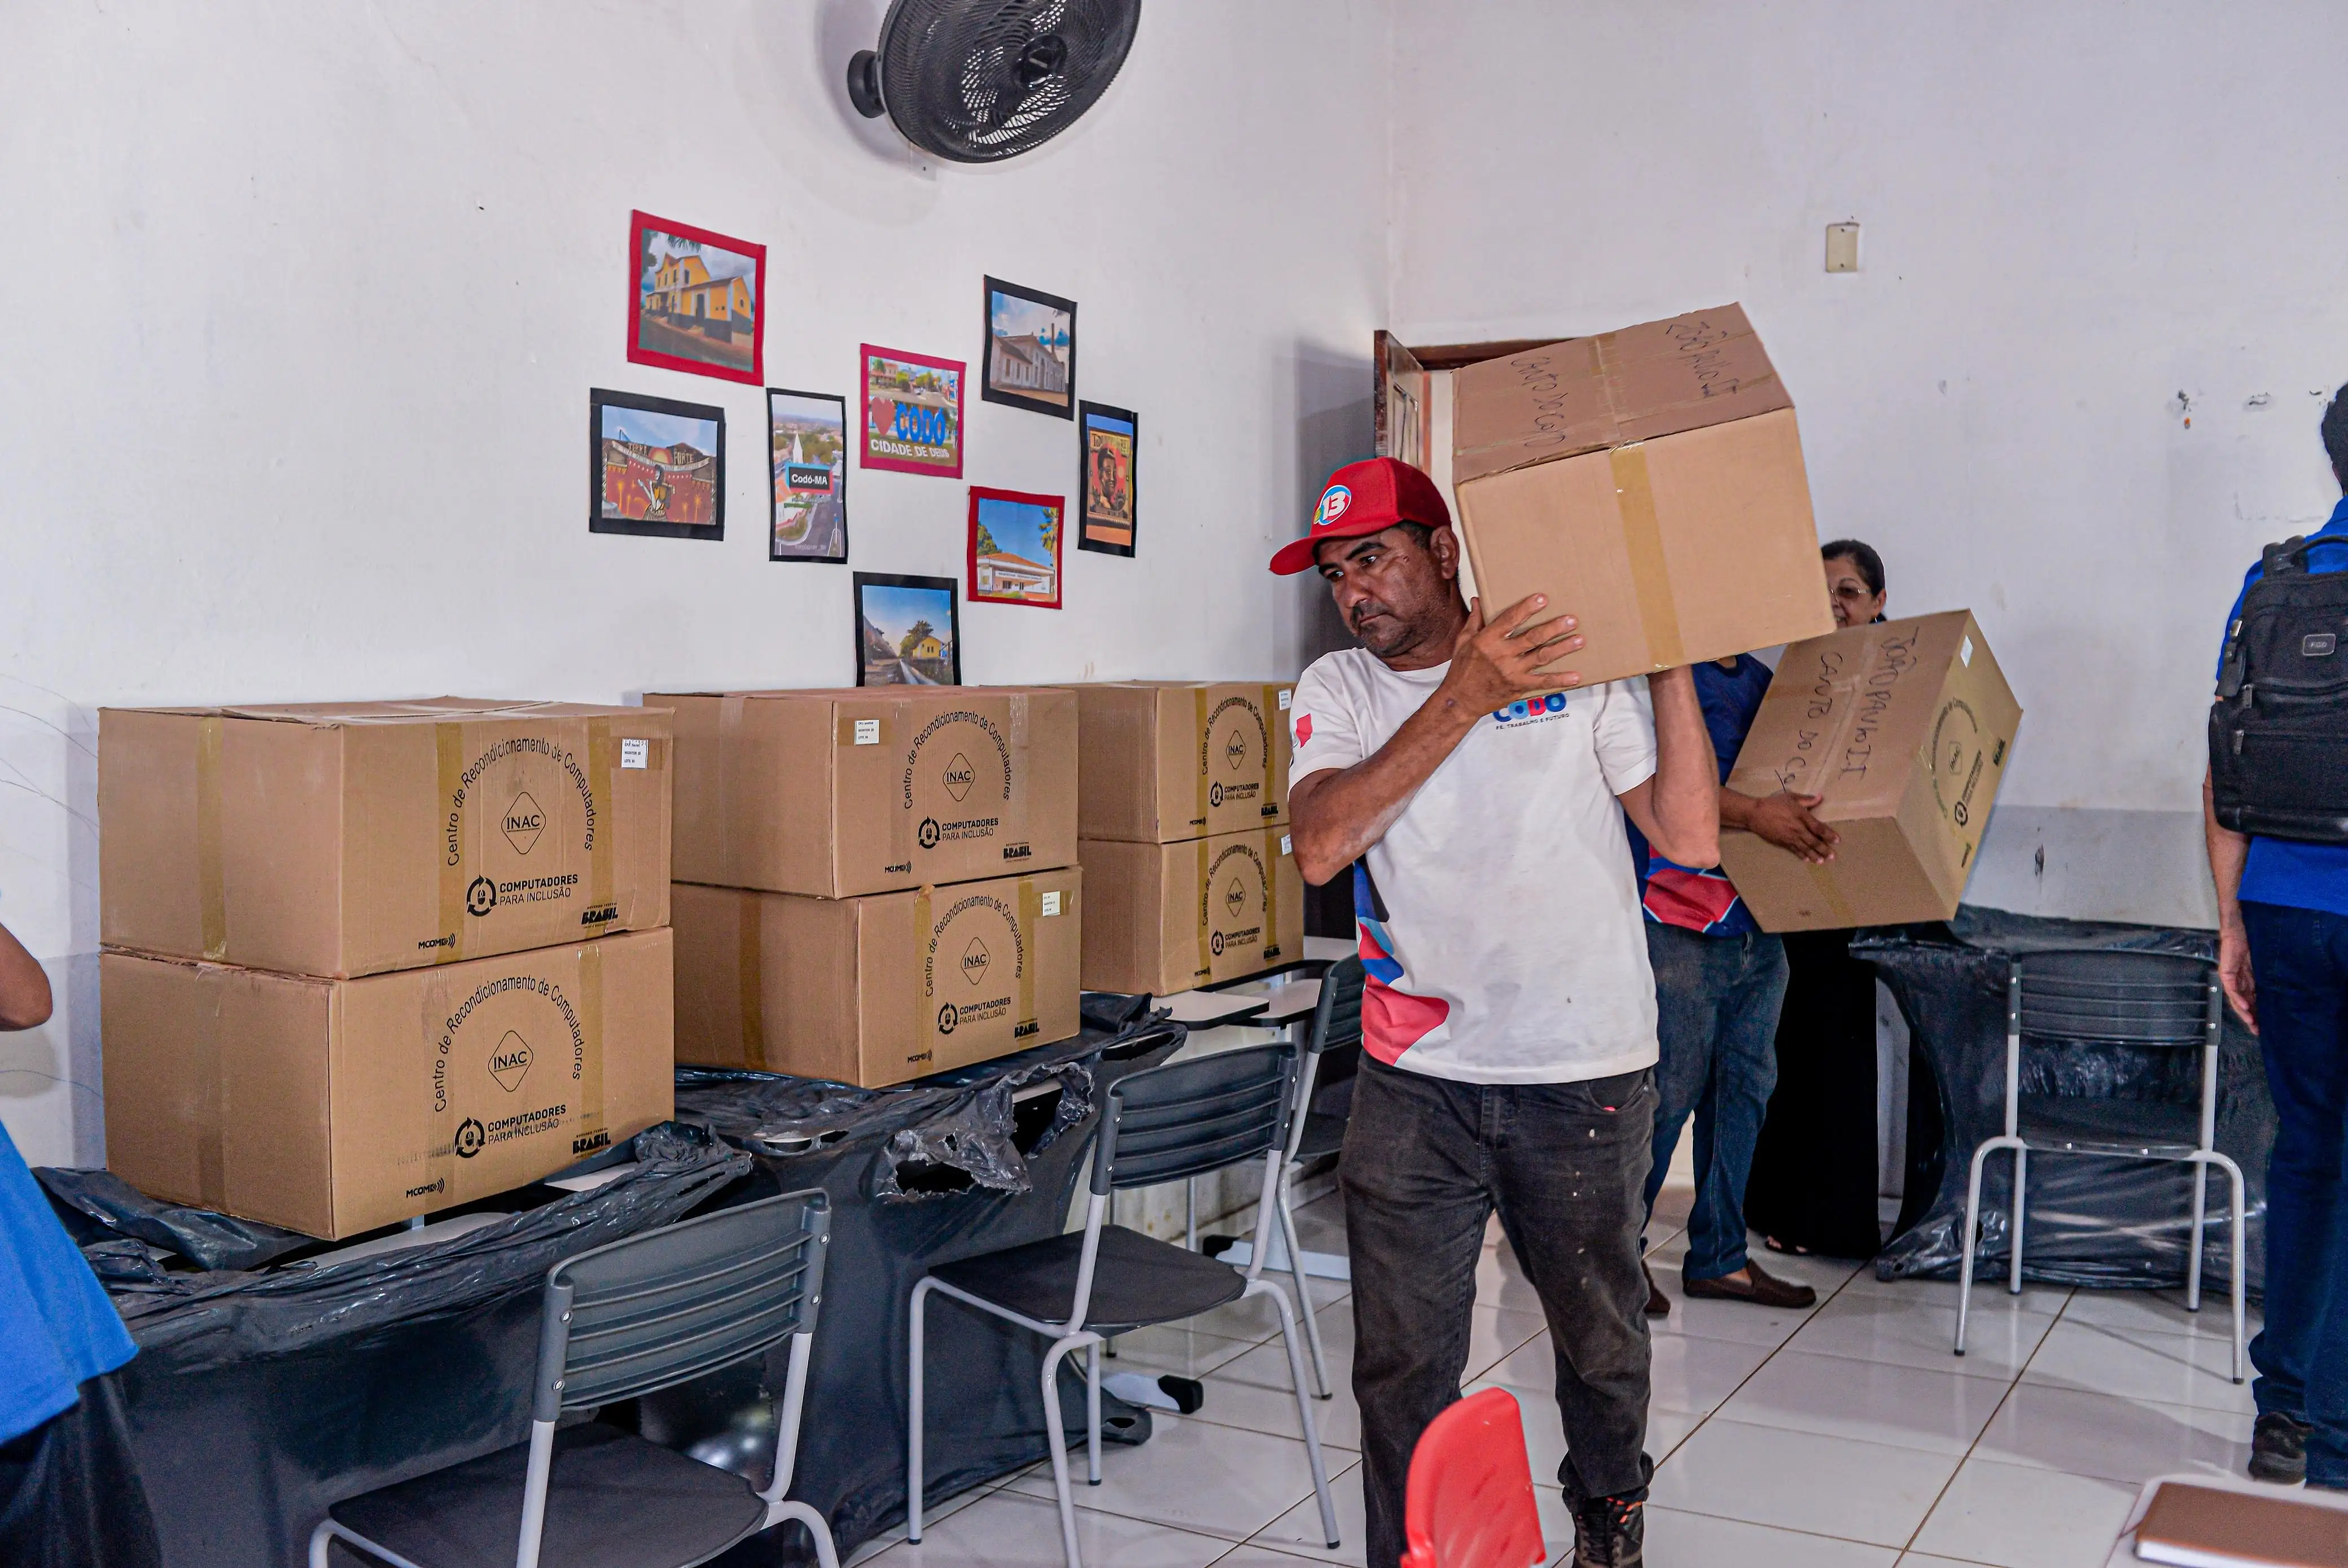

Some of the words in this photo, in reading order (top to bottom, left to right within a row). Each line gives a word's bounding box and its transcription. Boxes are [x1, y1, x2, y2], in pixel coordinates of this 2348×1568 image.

[896, 401, 945, 446] CODÓ
[870, 439, 913, 456] CIDADE
[914, 445, 928, 457] DE
[929, 447, 950, 458] DEUS
[791, 474, 828, 485] Codó-MA
[1322, 490, 1346, 520] 13
[1204, 727, 1211, 740] de
[1247, 700, 1253, 712] de
[1506, 719, 1539, 729] TRABALHO
[1545, 713, 1570, 722] FUTURO
[1228, 744, 1244, 754] INAC
[903, 768, 913, 809] Centro
[908, 750, 917, 765] de
[913, 711, 978, 750] Recondicionamento
[980, 715, 988, 729] de
[989, 722, 1012, 800] Computadores
[947, 770, 971, 782] INAC
[1224, 782, 1259, 792] COMPUTADORES
[1236, 790, 1256, 800] INCLUSÃO
[446, 813, 459, 866] Centro
[453, 789, 466, 808] de
[461, 738, 550, 789] Recondicionamento
[564, 752, 597, 851] Computadores
[507, 815, 540, 830] INAC
[942, 817, 999, 831] COMPUTADORES
[942, 831, 960, 841] PARA
[961, 827, 994, 839] INCLUSÃO
[1003, 845, 1032, 859] BRASIL
[1206, 878, 1211, 890] de
[1248, 847, 1253, 859] de
[500, 874, 578, 893] COMPUTADORES
[500, 894, 524, 905] PARA
[526, 887, 571, 903] INCLUSÃO
[994, 898, 1002, 912] de
[1228, 891, 1243, 903] INAC
[581, 907, 619, 925] BRASIL
[934, 894, 993, 938] Recondicionamento
[1002, 904, 1024, 979] Computadores
[1225, 926, 1260, 940] COMPUTADORES
[1225, 940, 1237, 949] PARA
[1237, 935, 1258, 946] INCLUSÃO
[928, 938, 937, 953] de
[964, 954, 987, 967] INAC
[925, 957, 933, 997] Centro
[538, 978, 549, 996] de
[446, 974, 536, 1035] Recondicionamento
[960, 997, 1011, 1014] COMPUTADORES
[960, 1014, 976, 1025] PARA
[976, 1007, 1006, 1022] INCLUSÃO
[551, 986, 584, 1080] Computadores
[1014, 1022, 1040, 1039] BRASIL
[438, 1035, 451, 1054] de
[494, 1051, 527, 1070] INAC
[432, 1059, 447, 1112] Centro
[488, 1104, 566, 1132] COMPUTADORES
[488, 1129, 513, 1145] PARA
[515, 1118, 559, 1138] INCLUSÃO
[572, 1132, 611, 1155] BRASIL
